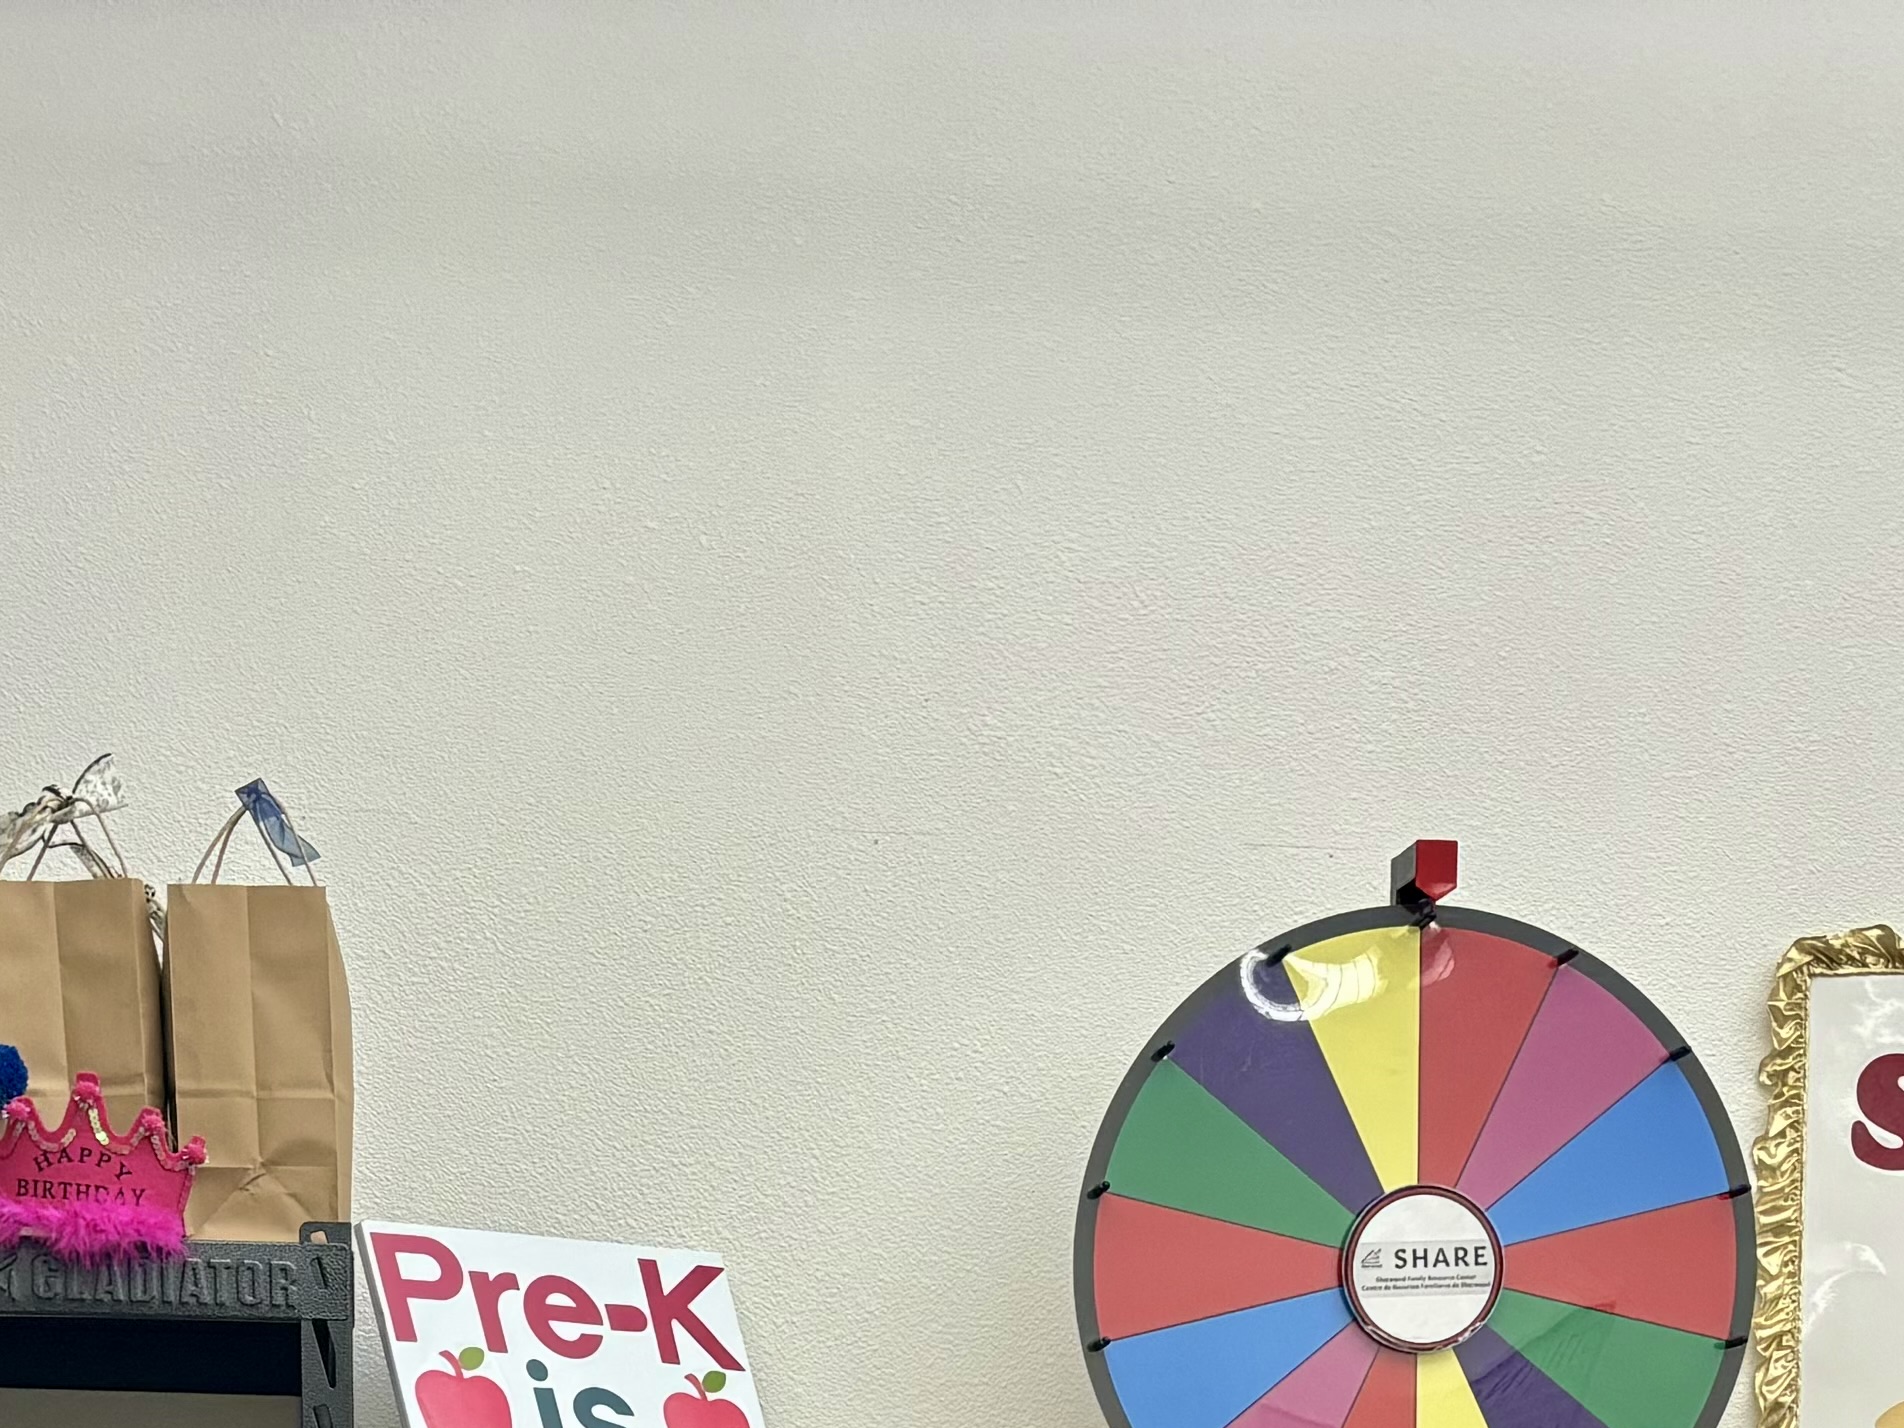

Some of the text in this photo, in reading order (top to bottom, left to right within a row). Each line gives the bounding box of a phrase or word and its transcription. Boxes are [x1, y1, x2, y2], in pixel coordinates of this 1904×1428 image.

[33, 1145, 134, 1182] HAPPY
[16, 1179, 147, 1209] BIRTHDAY
[1394, 1246, 1488, 1269] SHARE
[30, 1257, 297, 1309] GLADIATOR
[369, 1232, 746, 1372] Pre-K
